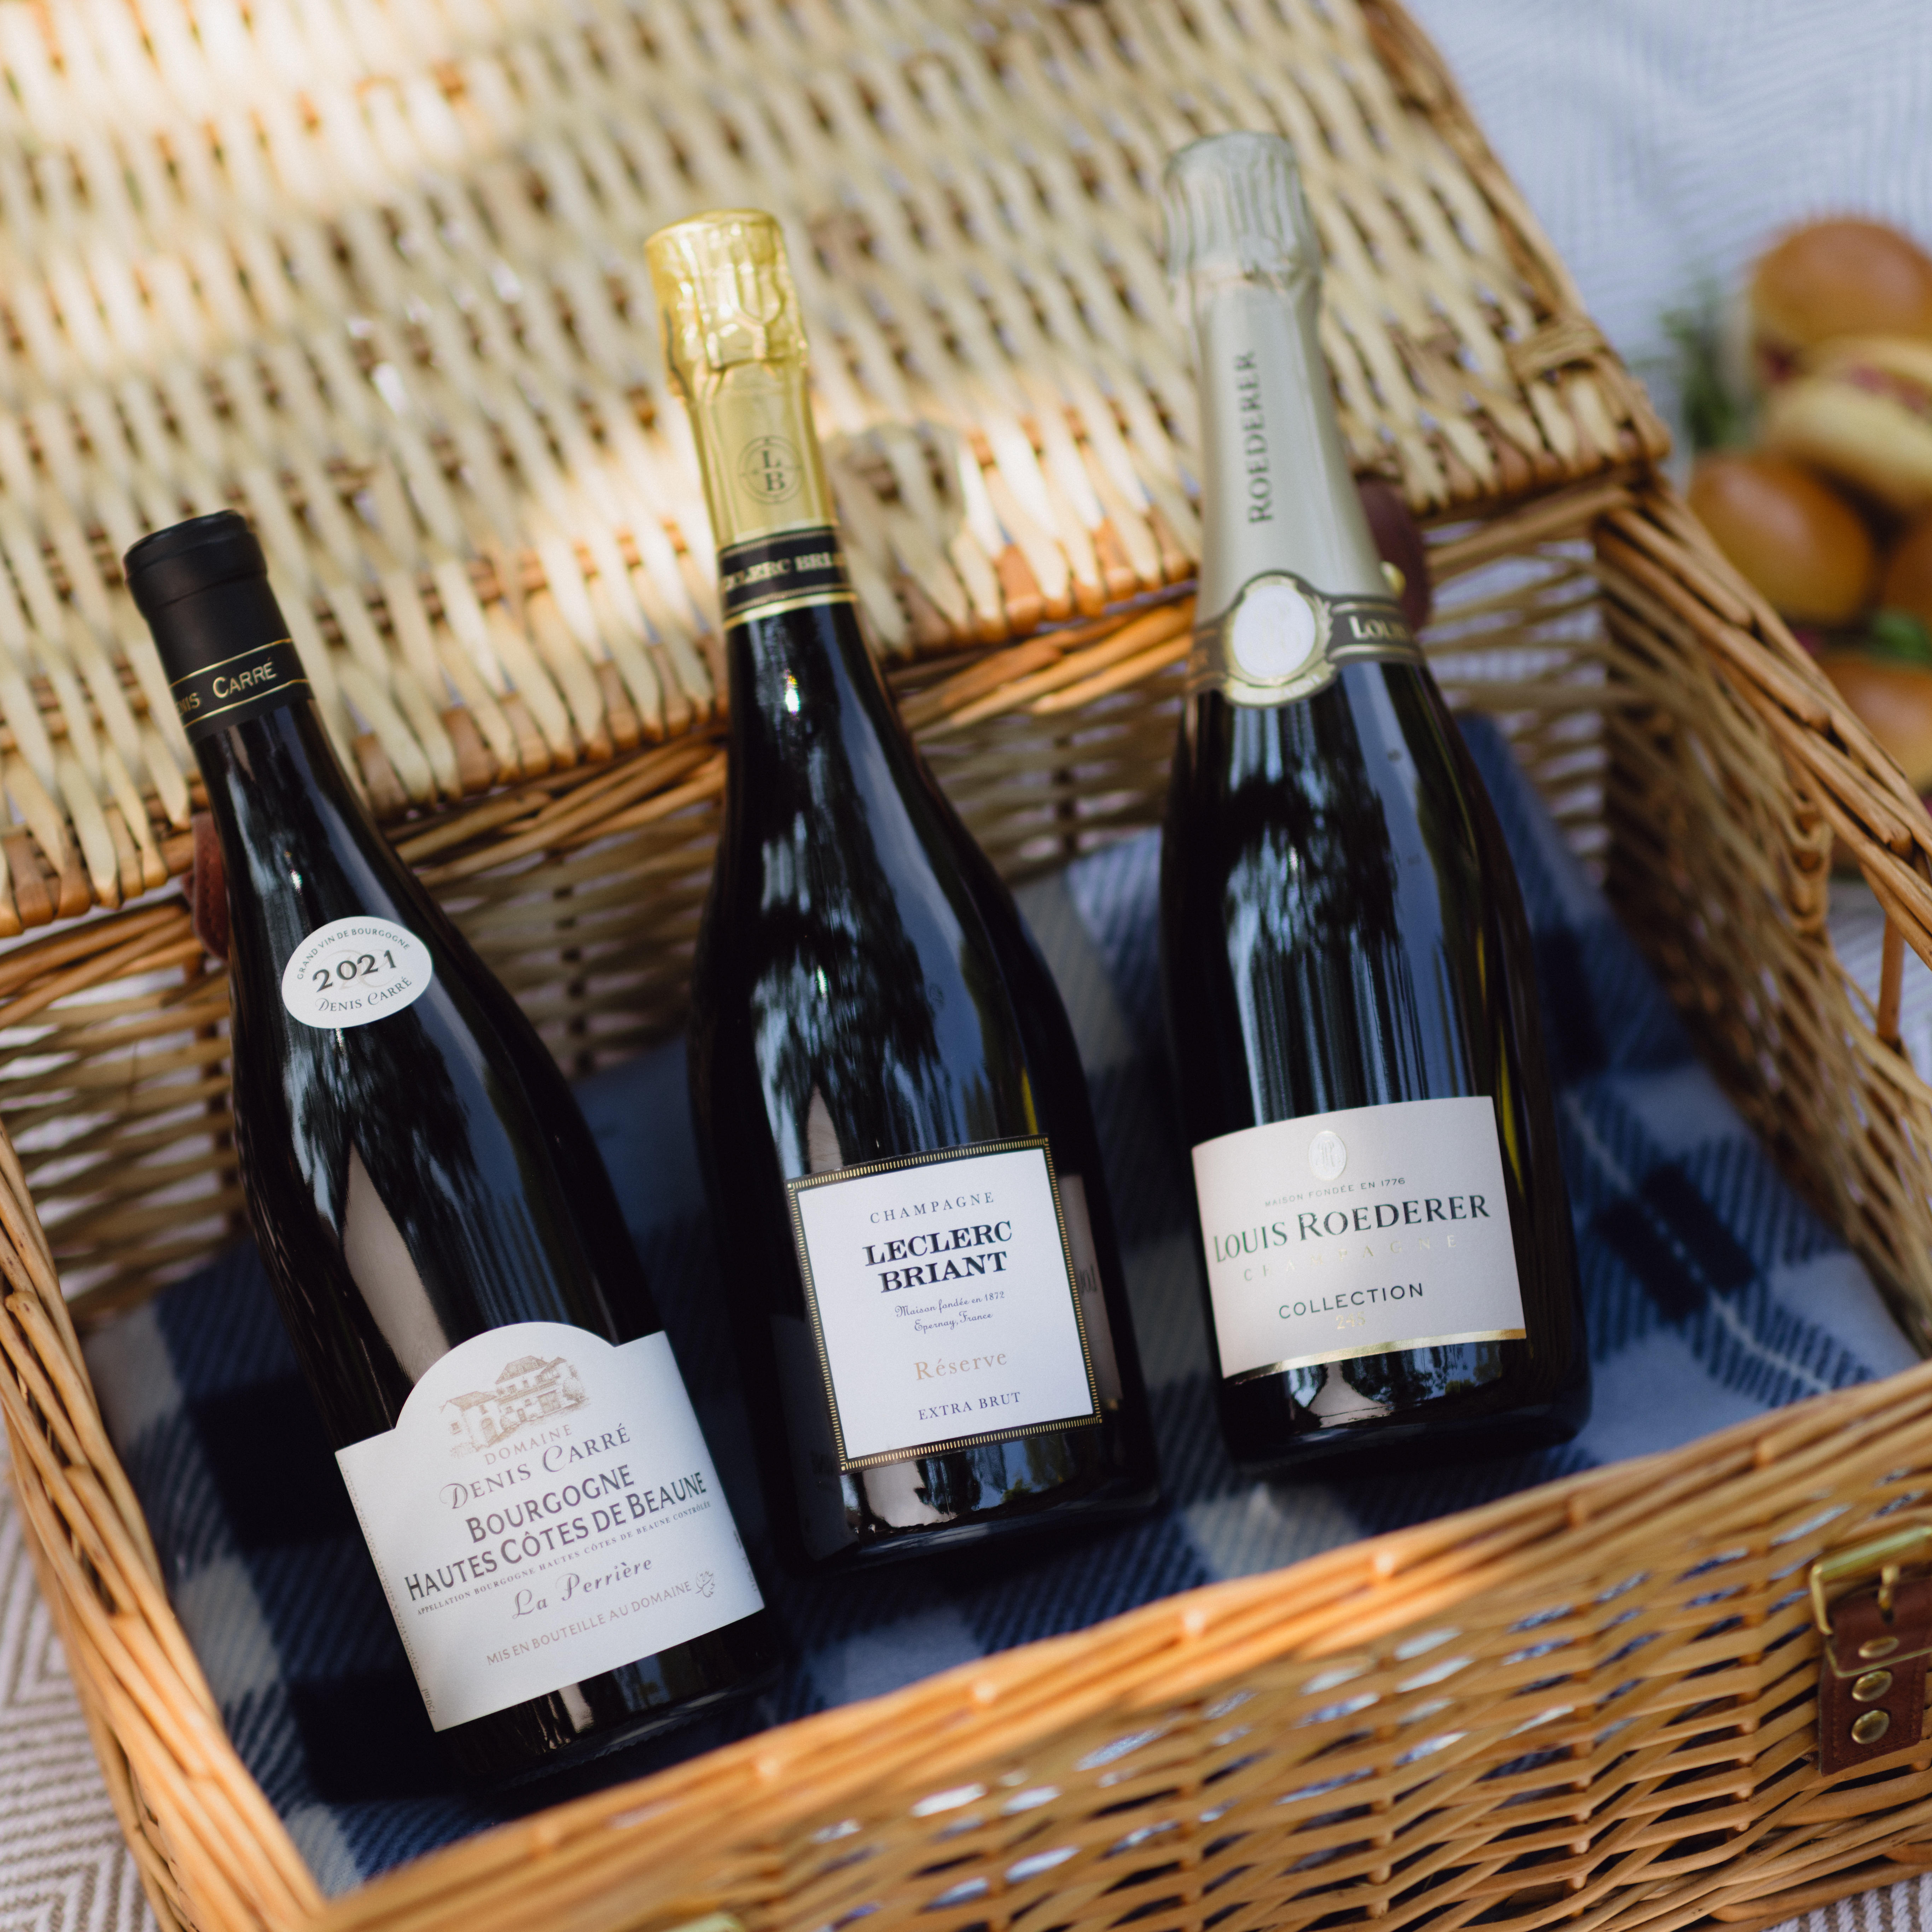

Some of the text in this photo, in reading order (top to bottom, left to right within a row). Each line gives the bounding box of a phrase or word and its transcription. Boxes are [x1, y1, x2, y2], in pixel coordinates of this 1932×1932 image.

[1235, 351, 1273, 523] ROEDERER
[213, 656, 277, 699] CARRÉ
[297, 928, 410, 980] GRAND VIN DE BOURGOGNE
[312, 949, 396, 992] 2021
[315, 976, 412, 1011] DENIS CARRÉ
[870, 1192, 994, 1223] CHAMPAGNE
[1265, 1178, 1406, 1207] MAISON FONDÉE EN 1776
[862, 1221, 1012, 1266] LECLERC
[1214, 1194, 1490, 1263] LOUIS ROEDERER
[878, 1251, 1007, 1293] BRIANT
[895, 1305, 937, 1318] Maison
[938, 1298, 970, 1313] fondée
[984, 1291, 1005, 1301] 1872
[959, 1311, 993, 1323] France
[1279, 1283, 1423, 1319] COLLECTION
[913, 1353, 1007, 1381] Réserve
[918, 1392, 1020, 1420] EXTRA BRUT
[439, 1423, 630, 1509] DENIS CARRÉ
[483, 1424, 572, 1465] DOMAINE
[465, 1464, 634, 1543] BOURGOGNE
[404, 1472, 706, 1601] HAUTES CÔTES DE BEAUNE
[418, 1500, 711, 1616] APPELLATION BOURGOGNE HAUTES CÔTES DE BEAUNE CONTRÔLÉE
[512, 1559, 652, 1619] La Perrière
[486, 1581, 692, 1666] MIS EN BOUTEILLE AU DOMAINE
